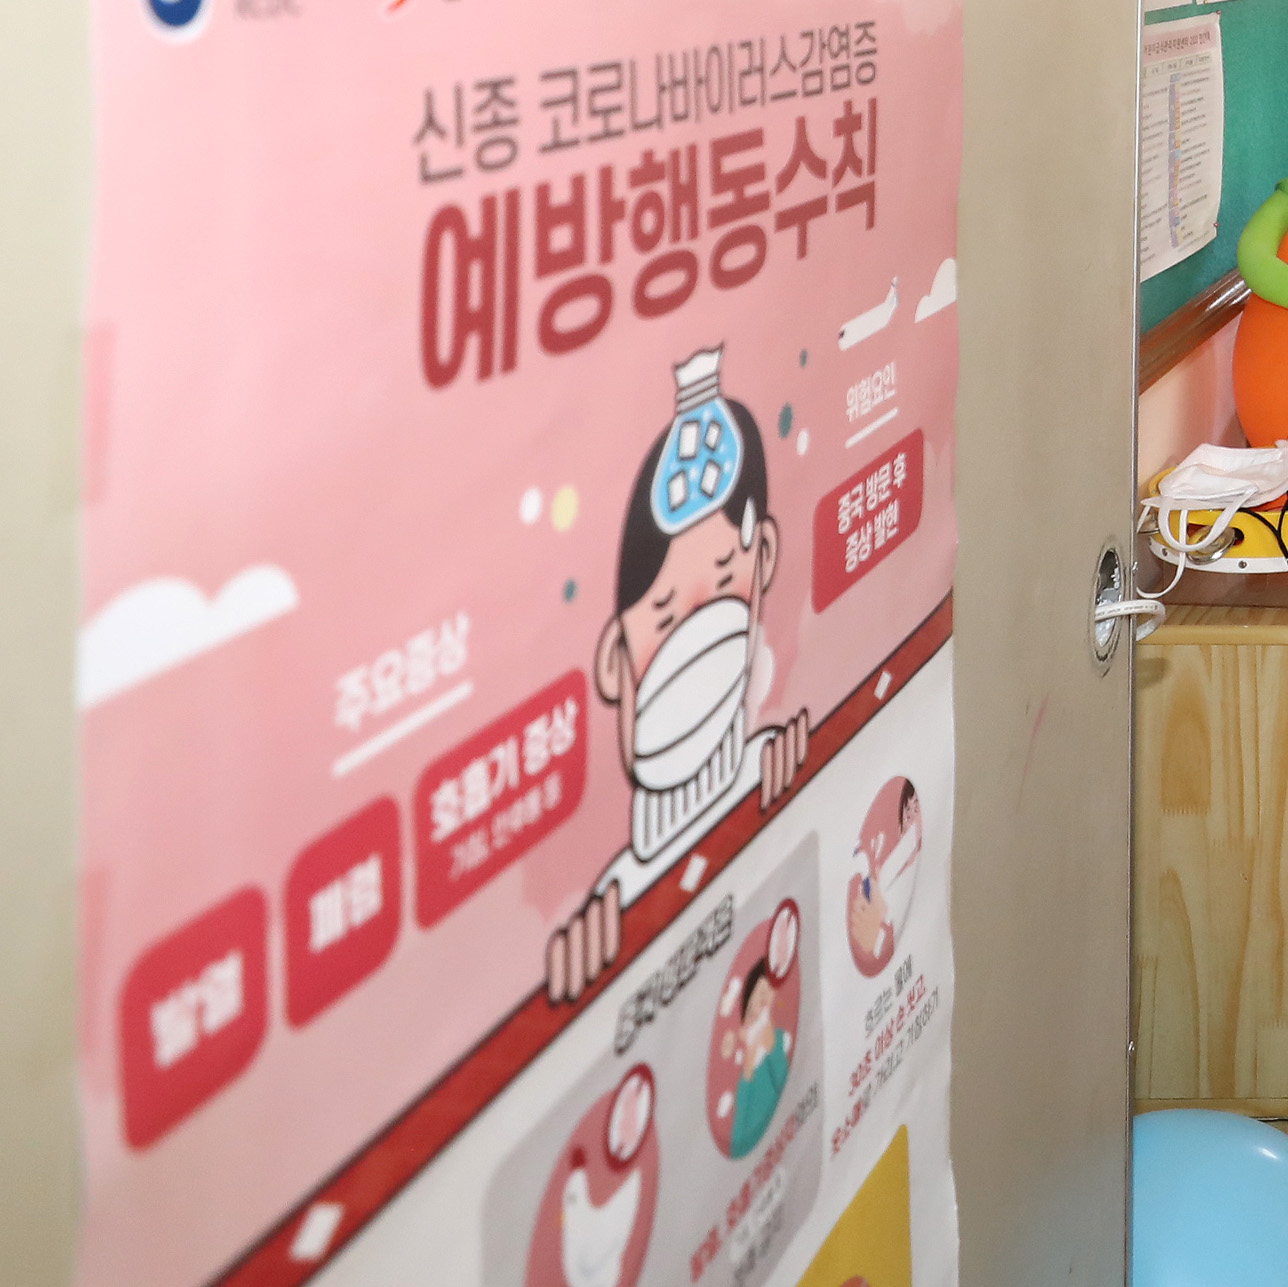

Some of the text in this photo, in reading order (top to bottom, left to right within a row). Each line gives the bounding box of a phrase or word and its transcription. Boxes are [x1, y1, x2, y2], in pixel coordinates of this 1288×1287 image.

[412, 20, 878, 185] 신종 코로나바이러스감염증
[419, 96, 878, 392] 예방행동수칙
[846, 361, 897, 422] 위험요인
[837, 452, 906, 534] 중국 방문 후
[845, 498, 899, 573] 증상 발현
[334, 609, 470, 732] 주요증상
[429, 695, 579, 844] 호흡기 증상
[874, 1017, 893, 1061] 이상
